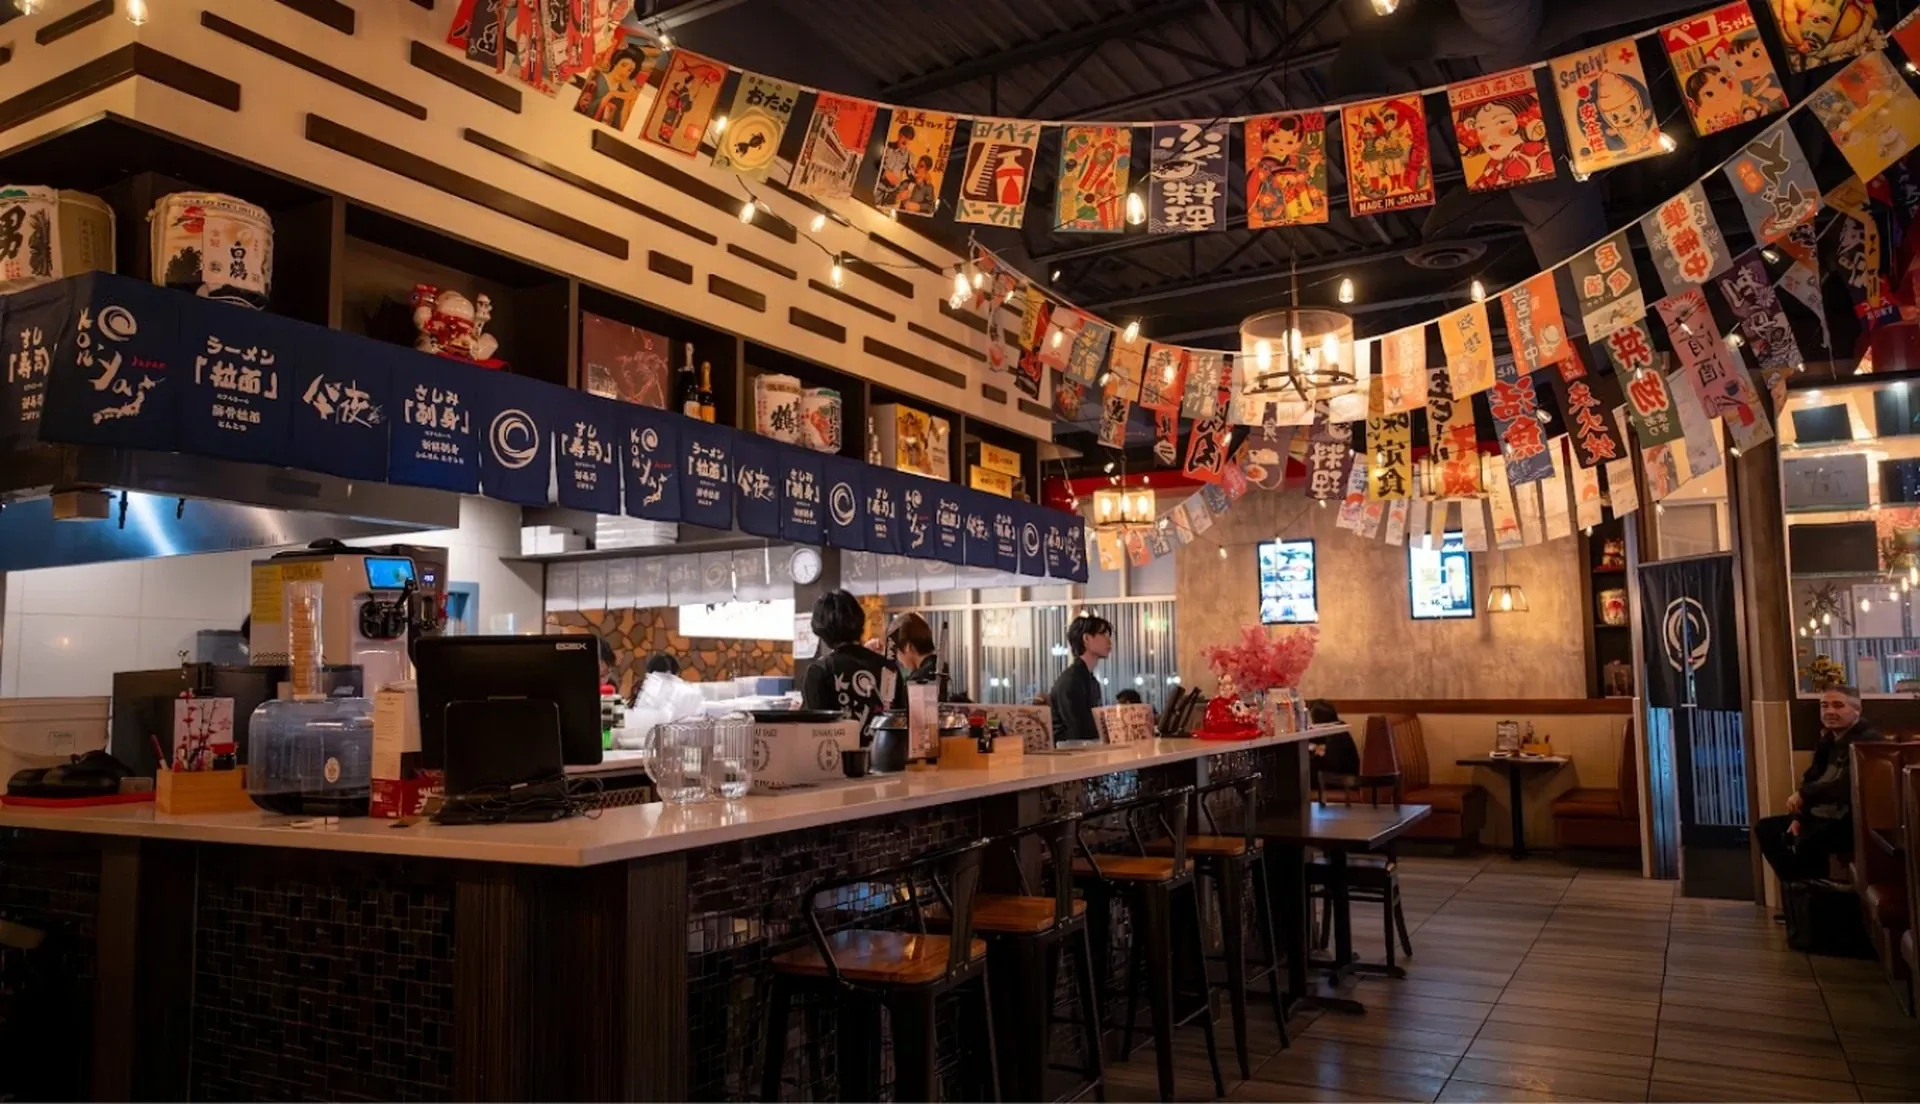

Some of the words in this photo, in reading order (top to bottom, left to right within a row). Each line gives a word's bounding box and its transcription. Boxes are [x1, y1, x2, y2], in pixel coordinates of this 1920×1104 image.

[1560, 48, 1609, 89] Safety!
[207, 335, 275, 365] ラーメン
